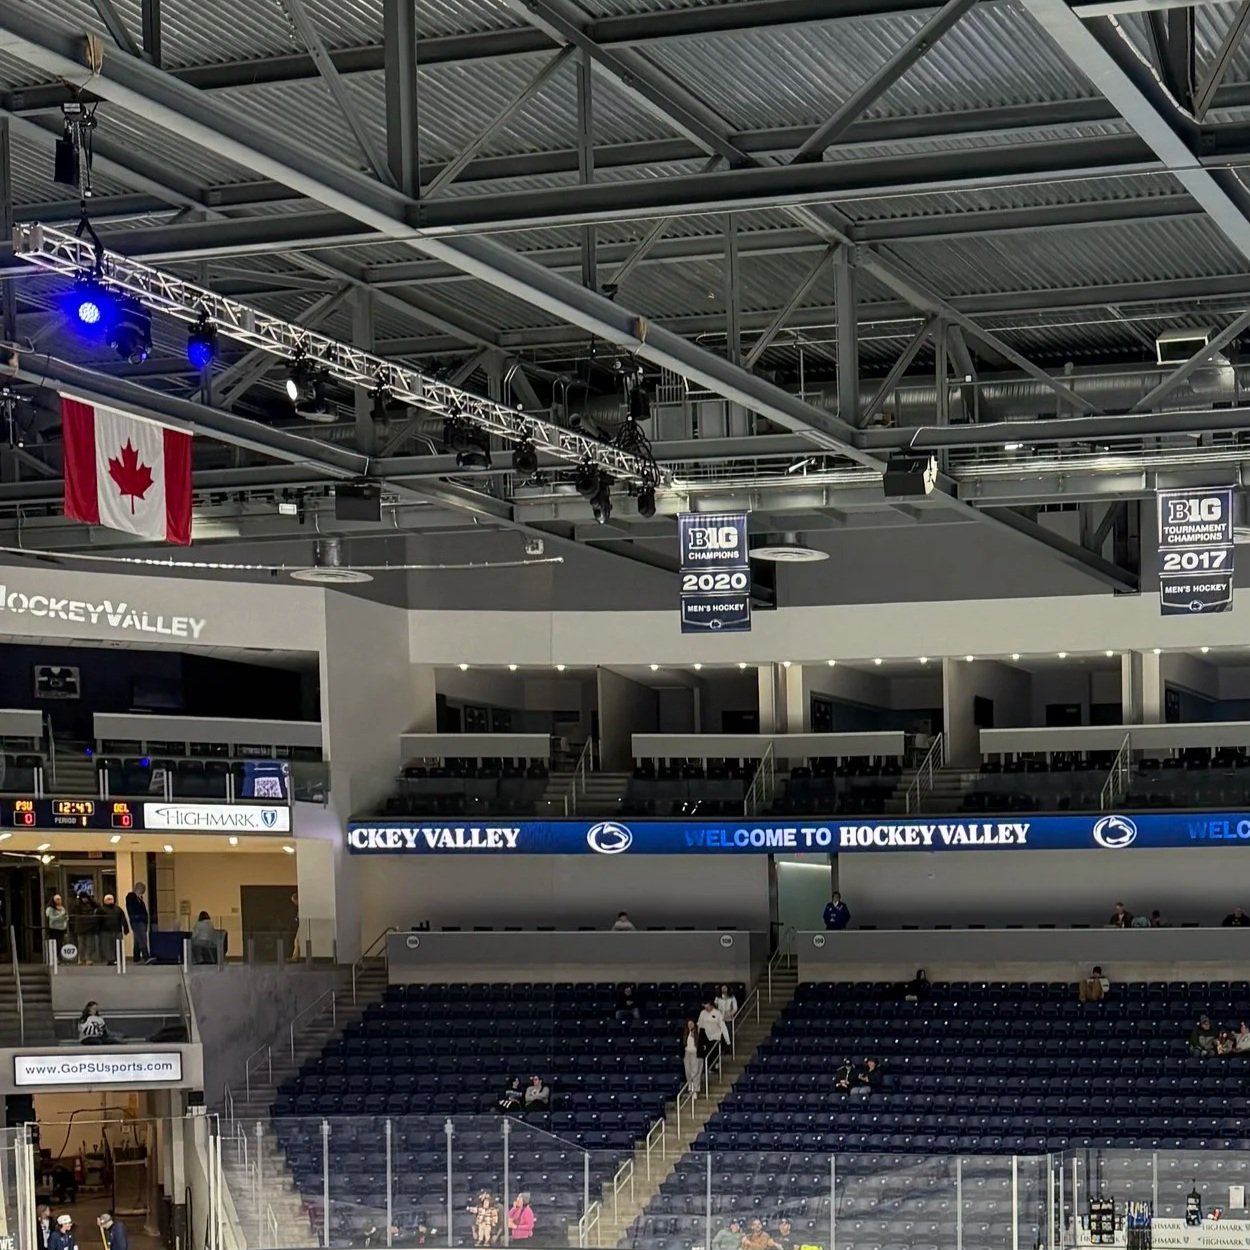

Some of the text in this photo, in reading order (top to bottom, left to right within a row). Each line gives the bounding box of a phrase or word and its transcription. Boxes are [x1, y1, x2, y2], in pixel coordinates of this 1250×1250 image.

[1164, 523, 1227, 534] TOURNAMENT
[1168, 533, 1222, 543] CHAMPIONS
[688, 551, 739, 560] CHAMPIONS
[1164, 551, 1227, 570] 2017
[682, 573, 747, 590] 2020
[1165, 584, 1227, 593] MEN'S HOCKEY
[16, 801, 33, 811] PSU
[59, 802, 92, 813] 12:47
[24, 814, 33, 824] 0
[122, 815, 130, 825] 0
[156, 807, 258, 828] HIGHMARK
[423, 828, 520, 849] VALLEY
[685, 823, 1030, 847] WELCOME TO HOCKEY VALLEY
[25, 1062, 173, 1075] www.GoPSUsports.com
